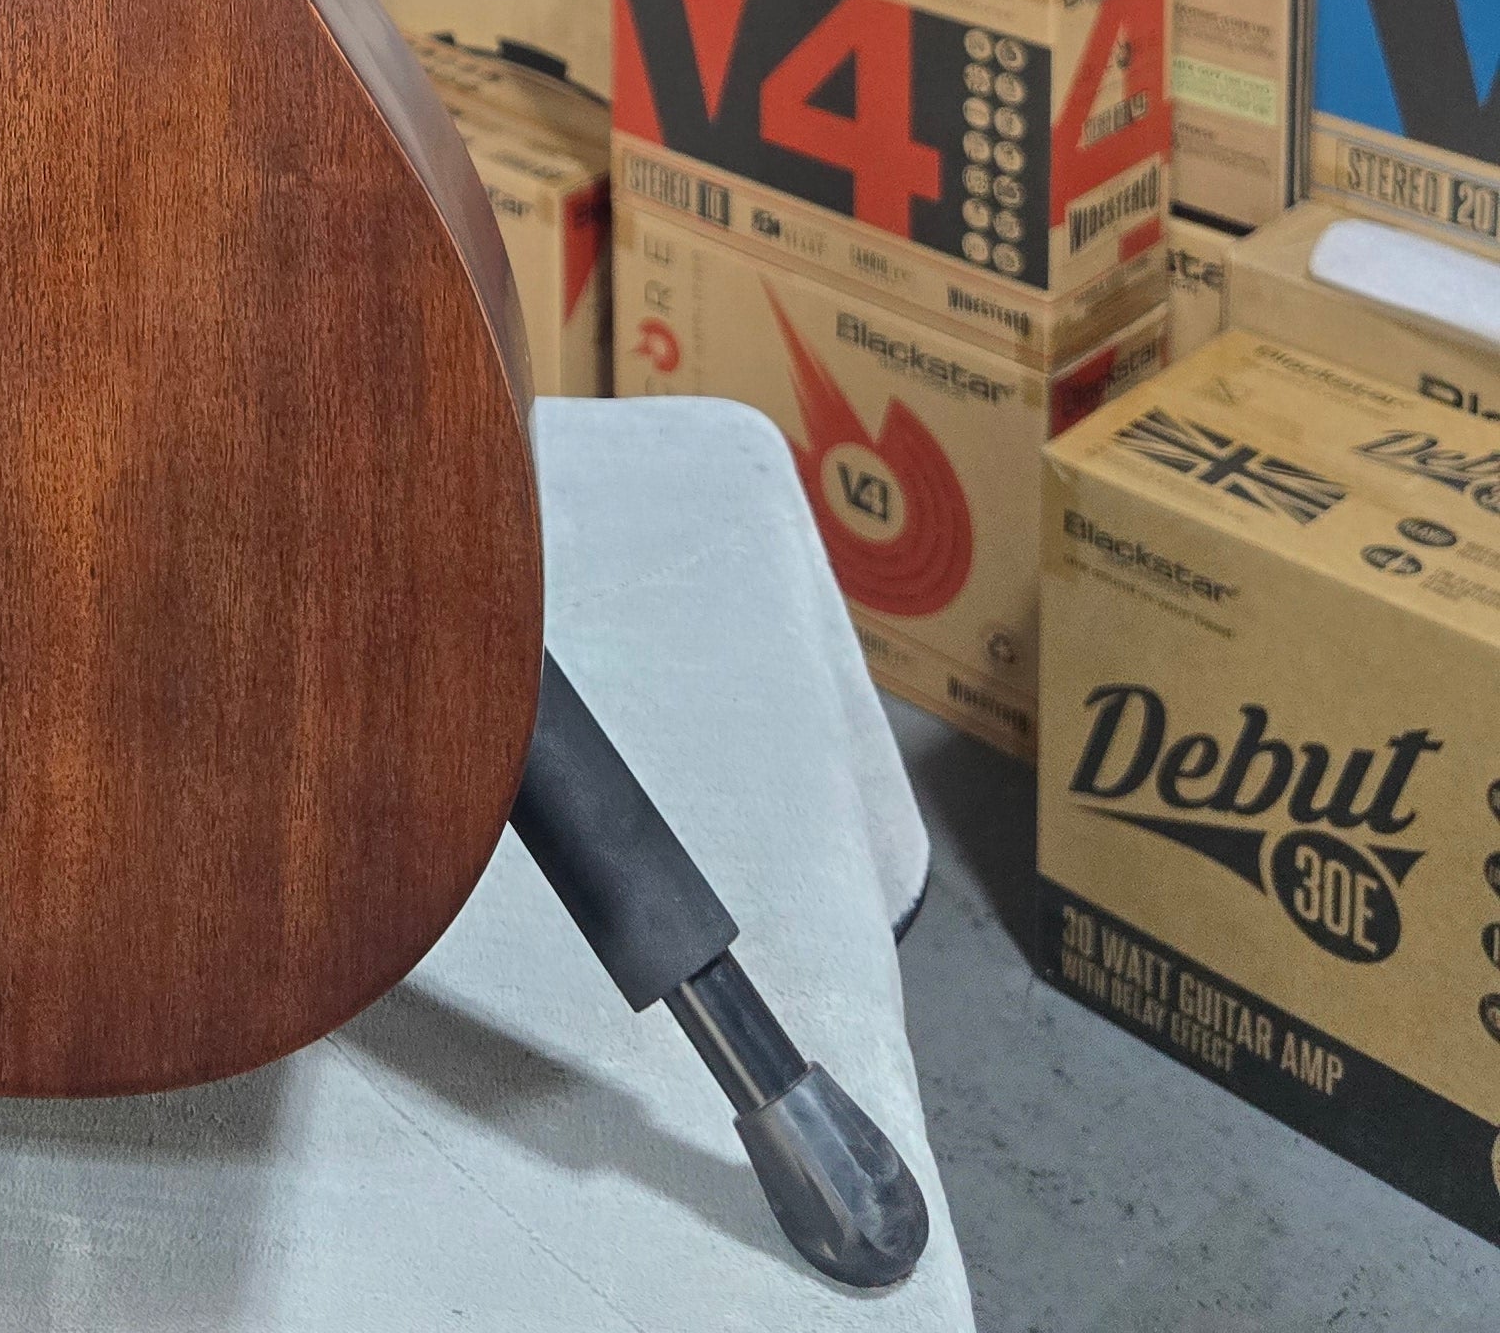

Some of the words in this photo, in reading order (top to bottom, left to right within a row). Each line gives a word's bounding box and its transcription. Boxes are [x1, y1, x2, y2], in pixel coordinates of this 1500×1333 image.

[629, 155, 691, 210] STEREO
[1069, 164, 1158, 256] WIDESTEREO
[1347, 146, 1440, 218] STEREO
[835, 310, 1013, 404] Blackstar
[1063, 507, 1233, 603] Blackstar
[1068, 682, 1445, 835] Debut
[1293, 844, 1378, 954] 30E
[1061, 948, 1105, 998] WITH
[1110, 971, 1165, 1029] DELAY
[1170, 1005, 1235, 1072] EFFECT
[1062, 904, 1094, 959] 30
[1100, 927, 1171, 1001] WATT
[1178, 972, 1273, 1061] GUITAR
[1280, 1031, 1344, 1097] AMP
